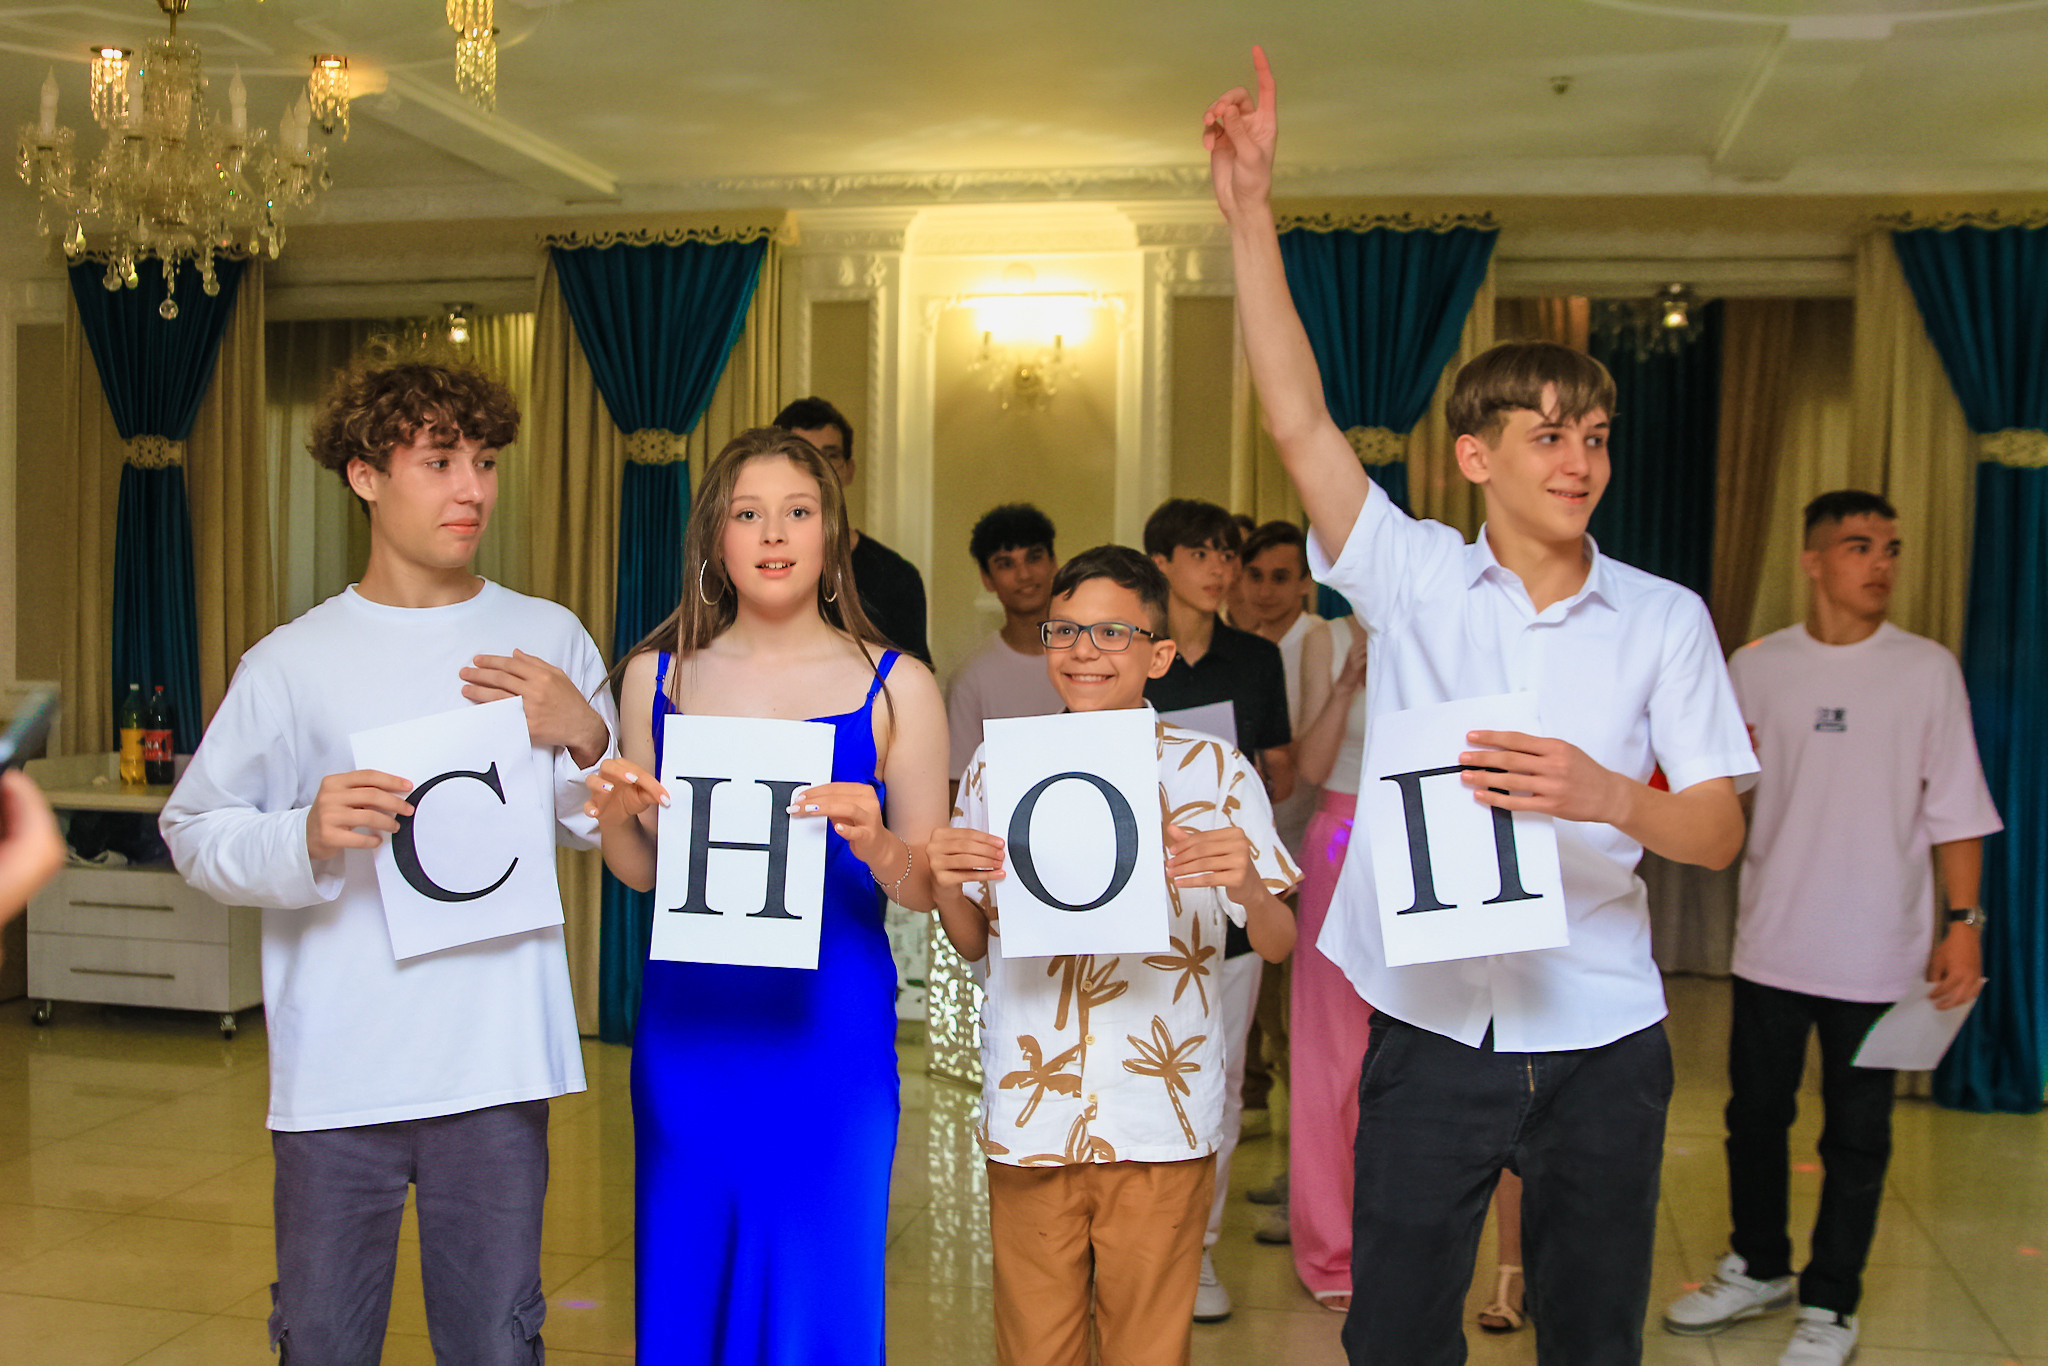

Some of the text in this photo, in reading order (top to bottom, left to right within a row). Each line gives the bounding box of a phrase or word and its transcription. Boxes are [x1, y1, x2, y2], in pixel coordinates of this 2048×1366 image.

[392, 761, 519, 902] С
[668, 775, 811, 920] Н
[1007, 771, 1139, 912] О
[1379, 763, 1544, 916] П
